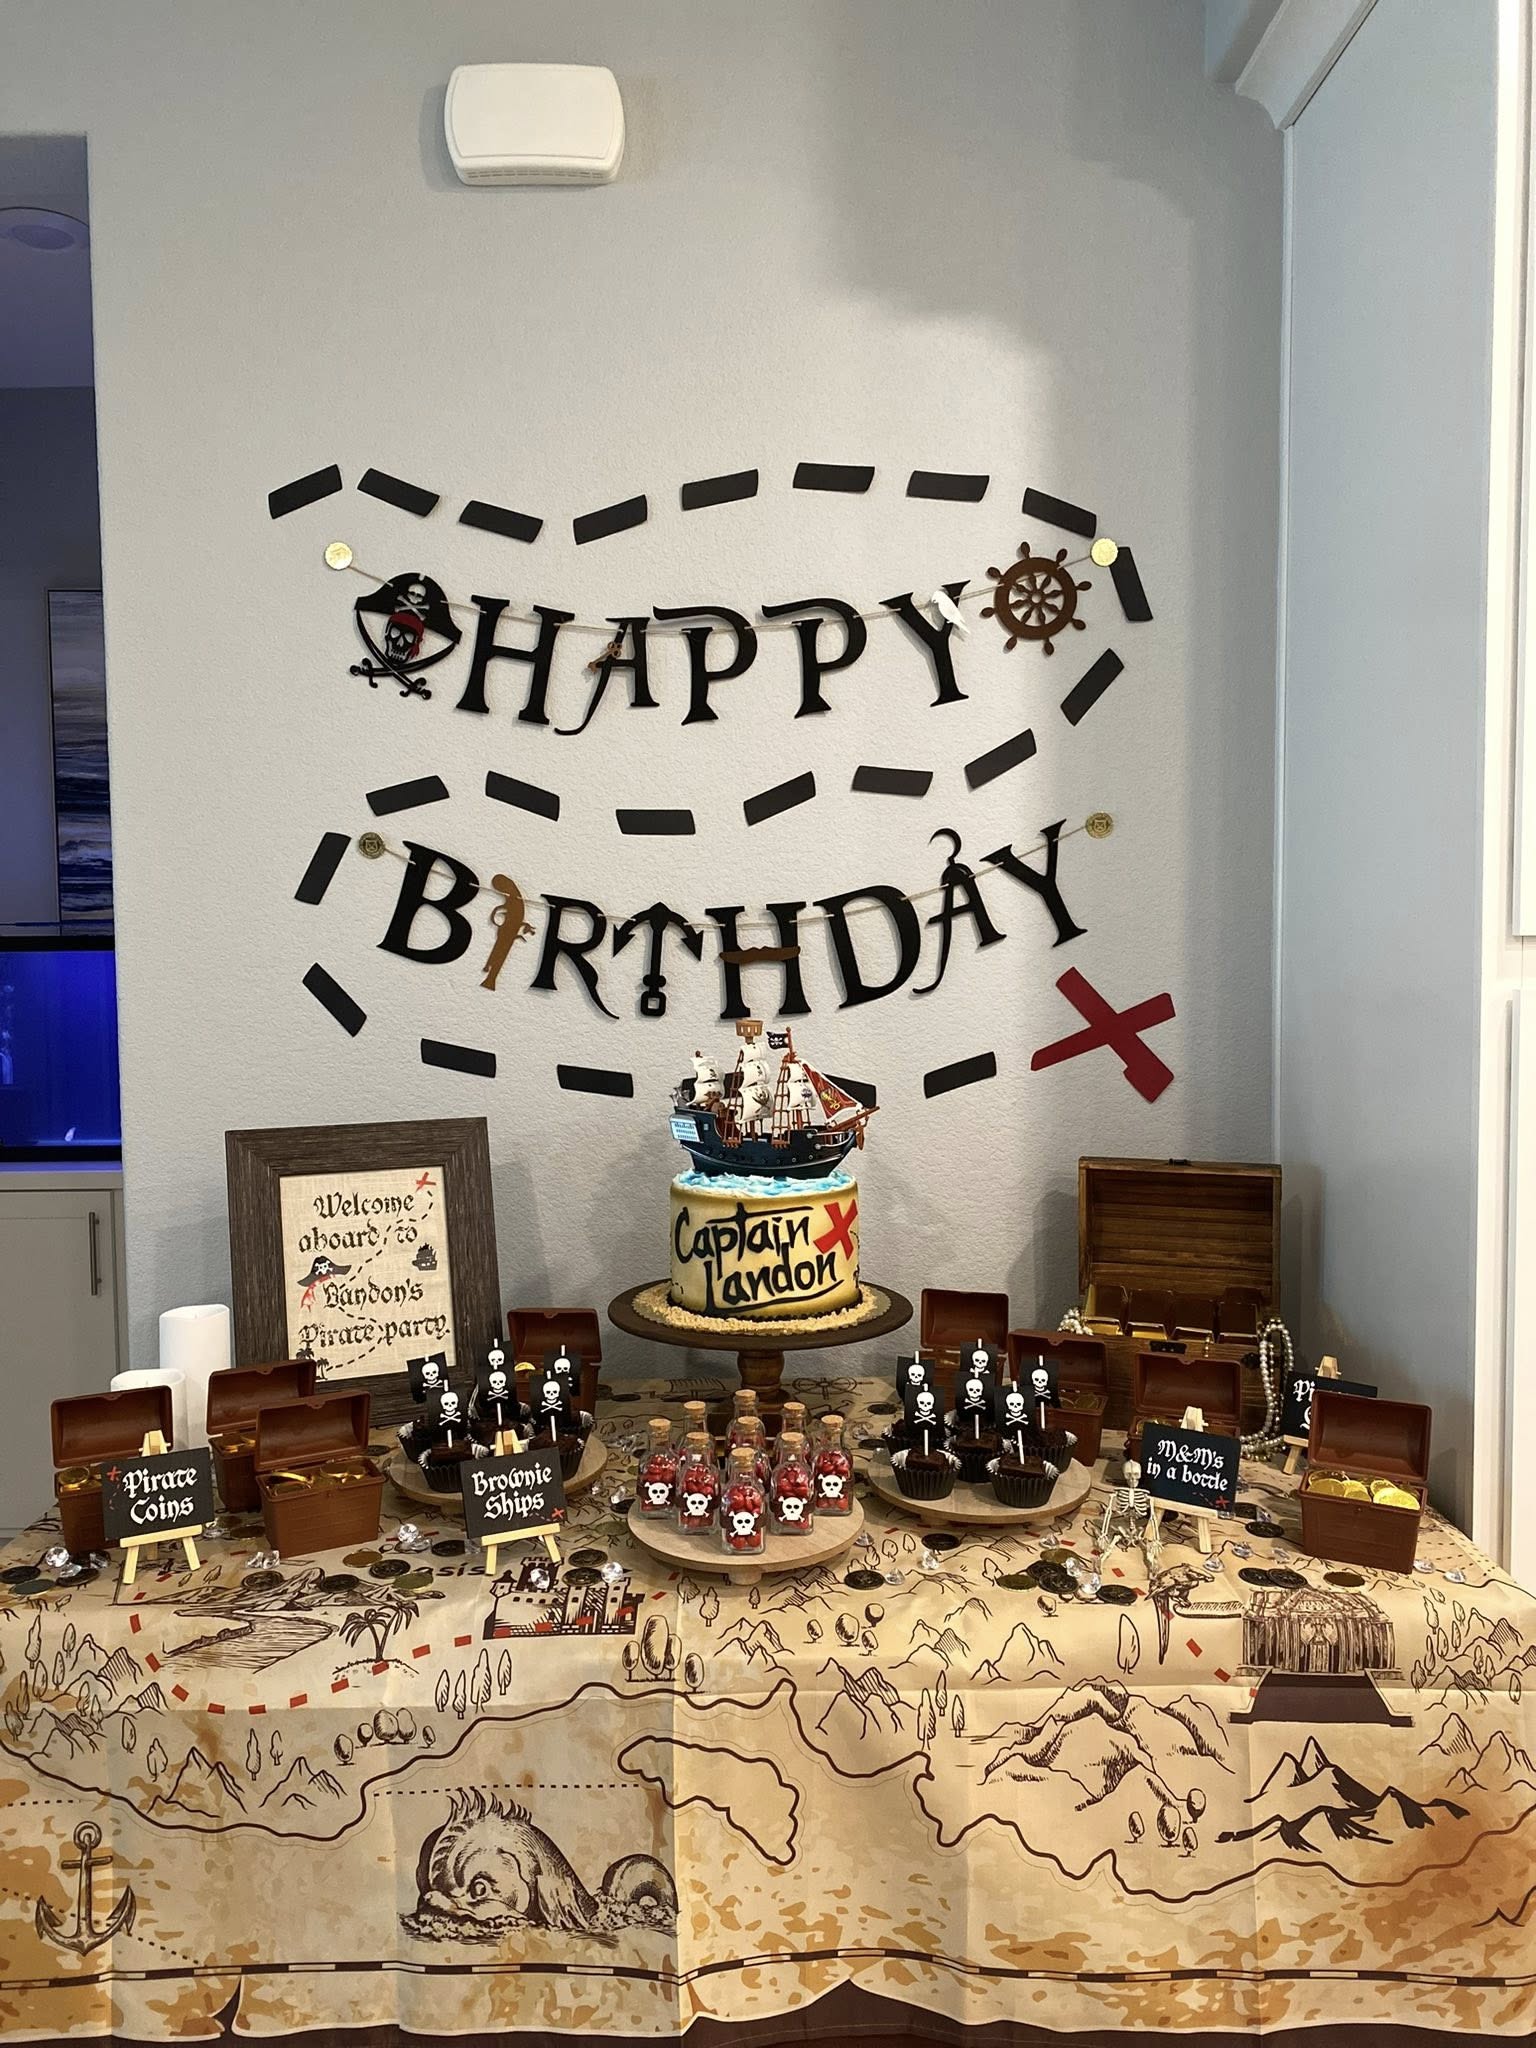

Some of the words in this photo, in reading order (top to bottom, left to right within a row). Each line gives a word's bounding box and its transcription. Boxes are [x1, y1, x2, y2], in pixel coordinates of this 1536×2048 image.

[455, 579, 971, 736] HAPPY
[313, 1191, 414, 1219] Welcome
[299, 1218, 380, 1252] aboard
[395, 1225, 418, 1243] to
[675, 1202, 814, 1281] Captain
[703, 1241, 844, 1318] Landon
[298, 1321, 375, 1349] Pirate
[1157, 1439, 1225, 1470] M&M's
[122, 1467, 198, 1499] Pirate
[471, 1461, 552, 1496] Brownie
[1146, 1456, 1161, 1479] in
[1166, 1466, 1177, 1480] a
[1182, 1464, 1229, 1491] bottle
[130, 1494, 194, 1525] Coins
[483, 1490, 545, 1521] Ships
